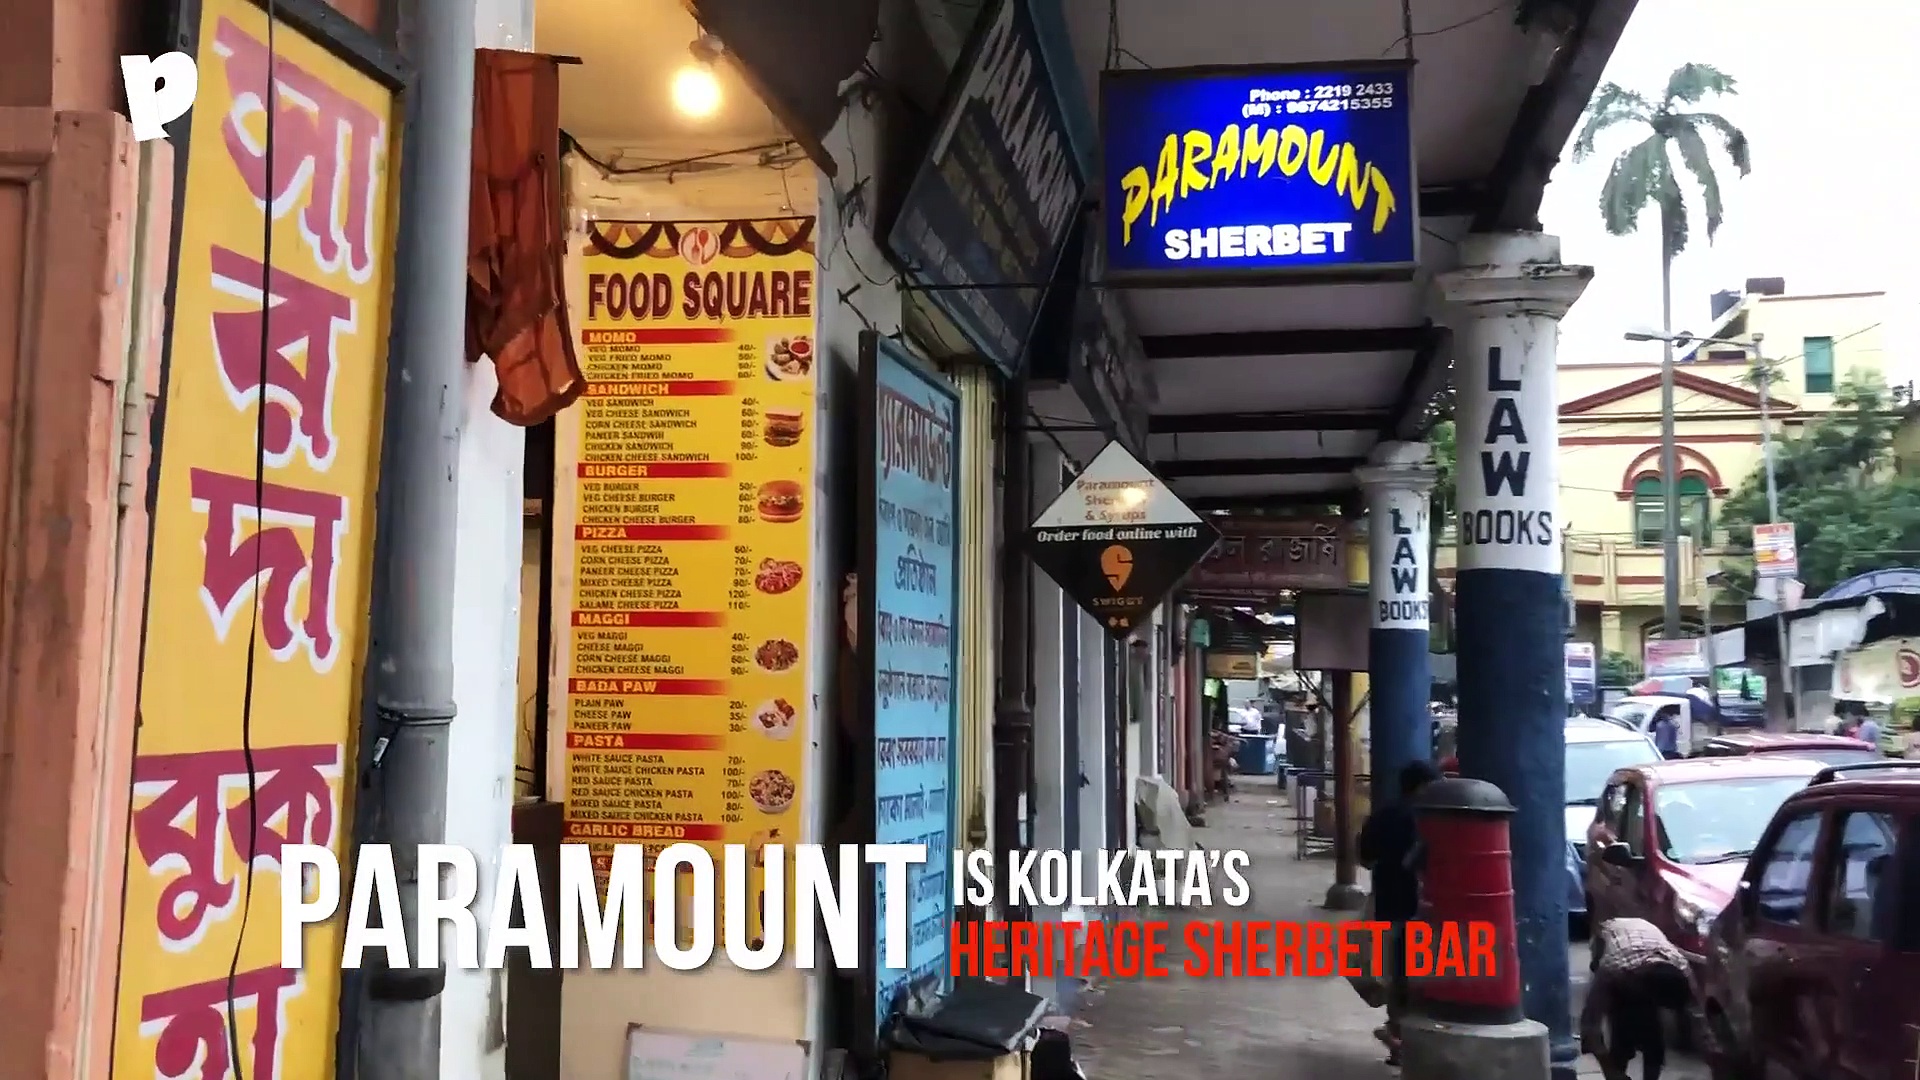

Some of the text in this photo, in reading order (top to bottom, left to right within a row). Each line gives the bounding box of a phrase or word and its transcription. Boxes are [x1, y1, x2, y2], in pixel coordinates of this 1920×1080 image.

[1250, 83, 1393, 101] Phone 2219 2433
[932, 0, 1077, 246] PARAMOUNT
[1121, 123, 1396, 246] PARAMOUNT
[1164, 223, 1352, 260] SHERBET
[588, 270, 812, 323] FOOD SQUARE
[190, 16, 385, 673] সারদা
[589, 332, 636, 343] MOMO
[587, 383, 669, 395] SANDWICH
[1481, 346, 1530, 497] LAW
[585, 466, 648, 477] BURGER
[1085, 510, 1146, 523] & Syups
[582, 527, 627, 538] PIZZA
[1037, 526, 1198, 542] Order food online with
[1462, 509, 1553, 546] BOOKS
[1390, 508, 1419, 594] LAW
[1379, 600, 1429, 621] BOOKS
[579, 614, 630, 625] MAGGI
[576, 681, 657, 692] BADA PAW
[730, 701, 747, 709] 20/-
[574, 736, 624, 747] PASTA
[722, 768, 744, 776] 100/-
[721, 791, 744, 800] 100/-
[570, 824, 685, 838] GARLIC BREAD
[134, 743, 343, 953] বুক
